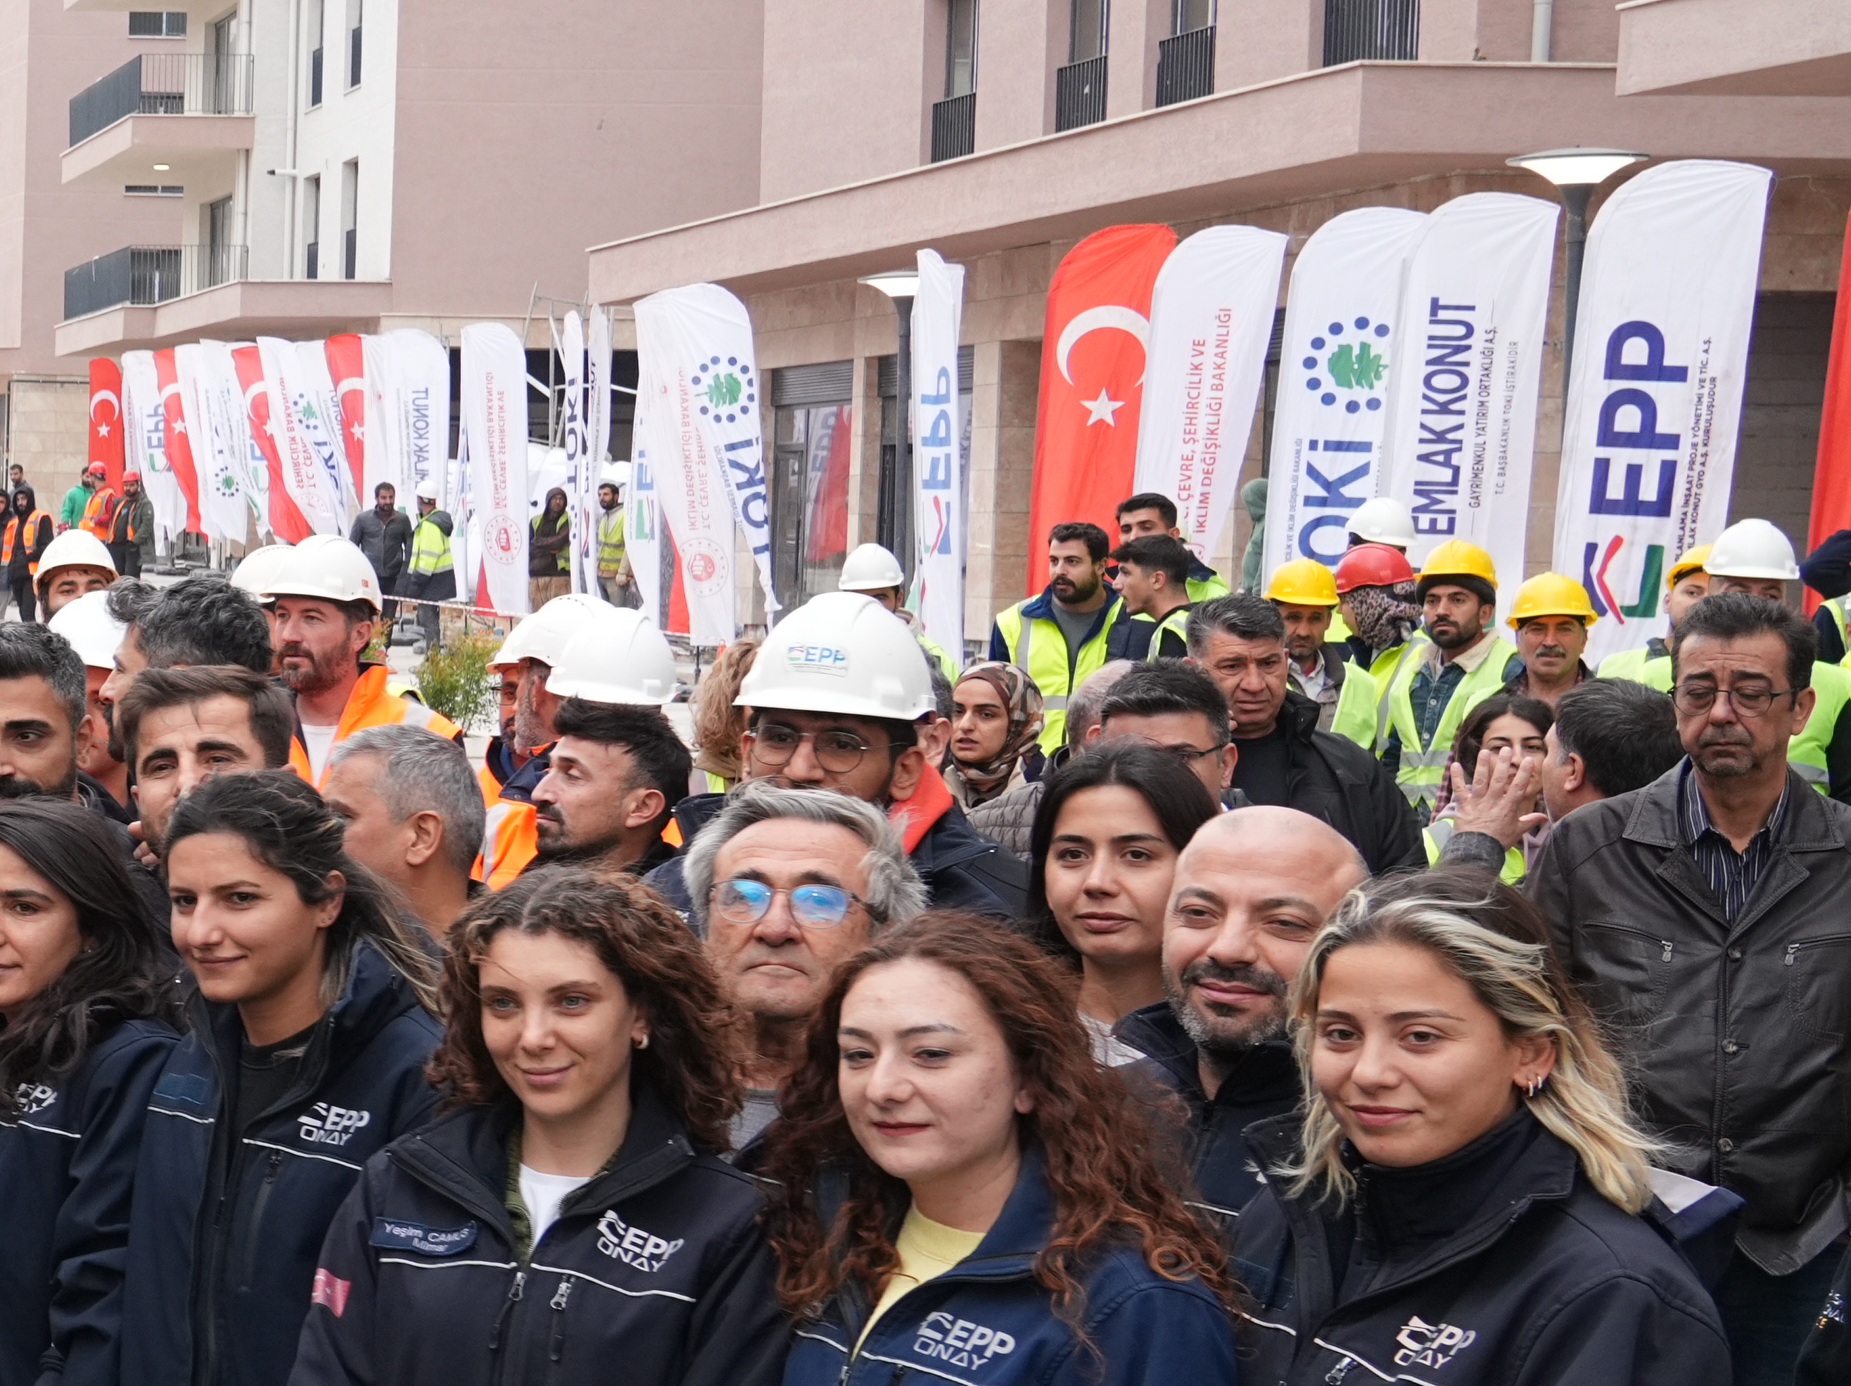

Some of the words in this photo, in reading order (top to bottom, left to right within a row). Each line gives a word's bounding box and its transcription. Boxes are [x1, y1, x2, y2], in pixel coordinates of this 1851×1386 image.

[1191, 339, 1206, 358] VE
[1209, 308, 1232, 392] BAKANLIĞI
[1482, 326, 1497, 344] A.Ş.
[1702, 337, 1713, 355] A.Ş.
[1421, 297, 1476, 416] KONUT
[1478, 347, 1494, 398] ORTAKLIĞI
[1503, 341, 1519, 392] İŞTİRAKİDİR
[1699, 357, 1708, 376] TİC.
[1698, 377, 1707, 390] VE
[1182, 362, 1203, 445] ŞEHİRCİLİK
[1474, 401, 1489, 437] YATIRIM
[1502, 395, 1513, 415] TOKİ
[1588, 320, 1688, 518] EPP
[1690, 393, 1706, 438] YÖNETİMİ
[1702, 377, 1717, 447] KURULUŞUDUR
[1199, 397, 1223, 487] DEĞİŞİKLİĞİ
[1497, 418, 1510, 478] BAŞBAKANLIK
[1687, 441, 1699, 472] PROJE
[1699, 450, 1709, 468] A.Ş.
[1178, 450, 1196, 502] ÇEVRE,
[1411, 422, 1466, 536] EMLAK
[1468, 441, 1486, 509] GAYRİMENKUL
[1681, 474, 1695, 509] İNŞAAT
[1696, 470, 1705, 490] GYO
[1193, 492, 1211, 534] İKLİM
[1298, 439, 1373, 567] OKİ
[1690, 492, 1702, 524] KONUT
[301, 1125, 352, 1146] ONAY
[326, 1105, 370, 1133] EPP
[384, 1223, 424, 1238] Yeşim
[621, 1227, 684, 1261] EPP
[597, 1236, 666, 1273] ONAY
[913, 1336, 989, 1371] ONAY
[948, 1319, 1016, 1359] EPP
